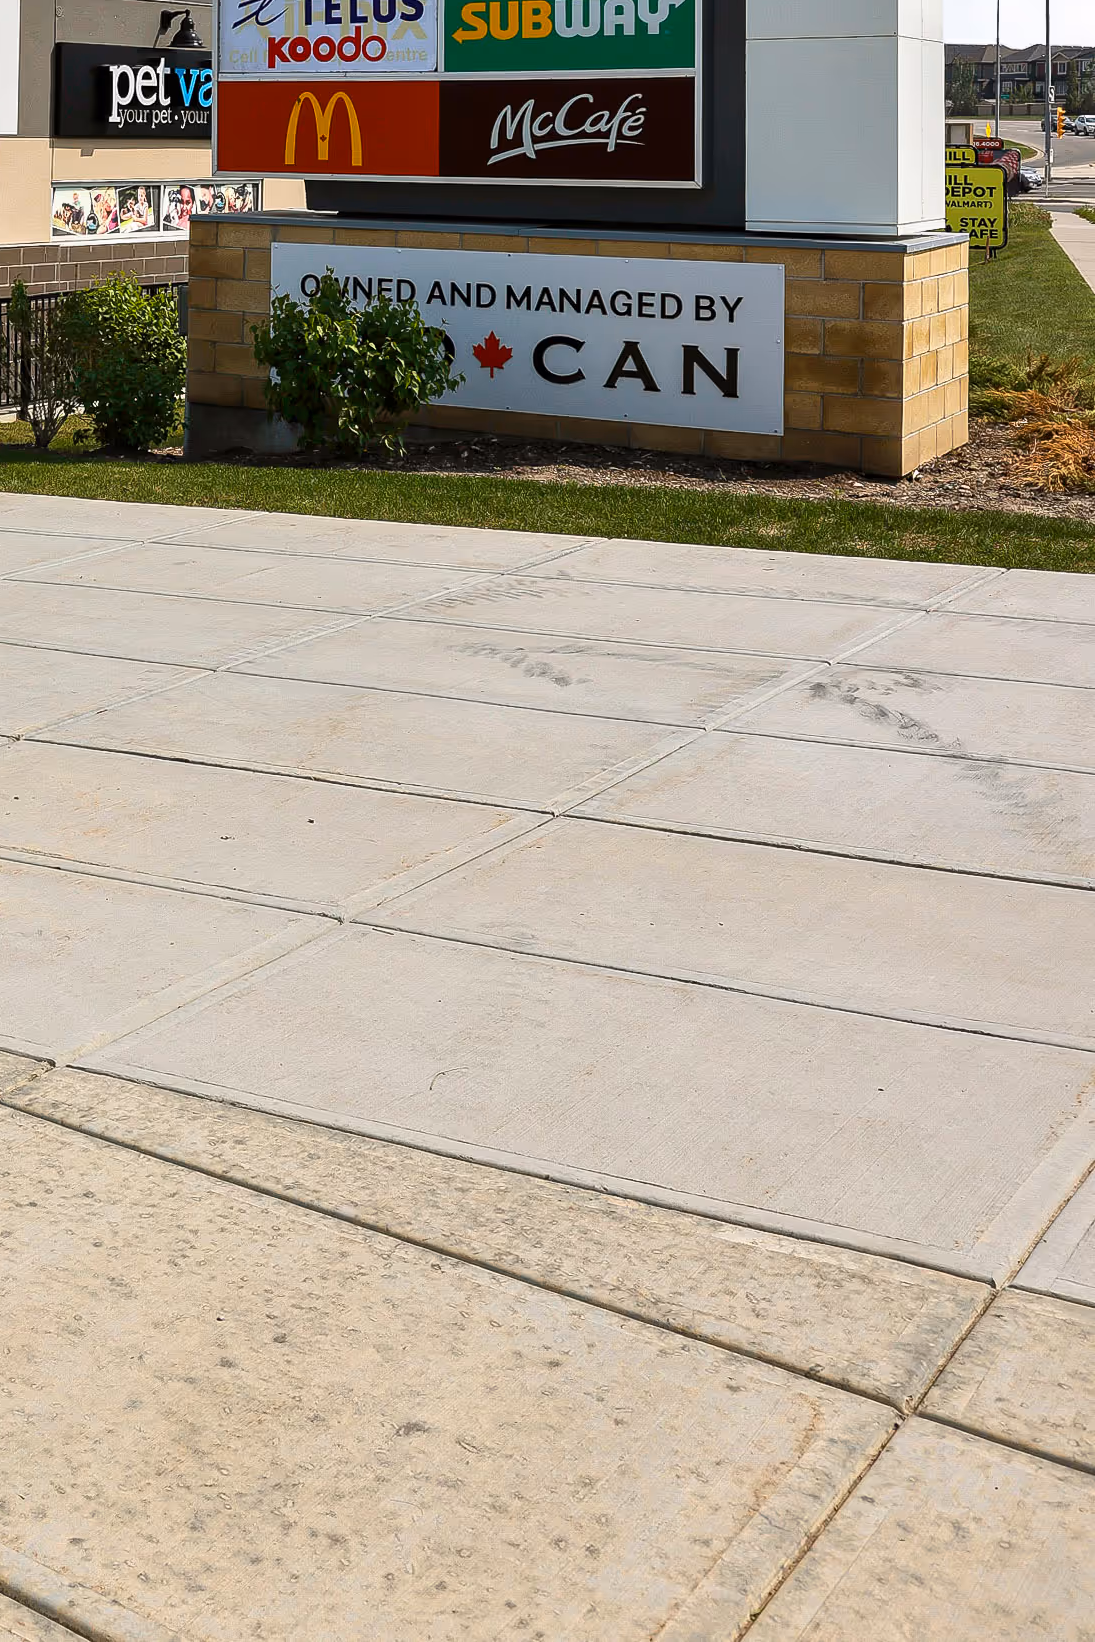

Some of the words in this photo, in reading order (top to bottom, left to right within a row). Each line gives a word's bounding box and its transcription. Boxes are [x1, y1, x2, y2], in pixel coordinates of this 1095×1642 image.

[109, 57, 171, 123] pet
[117, 108, 149, 128] your
[151, 107, 173, 129] pet
[181, 109, 209, 129] your
[488, 93, 647, 163] McCafé
[959, 217, 998, 229] STAY
[426, 280, 497, 309] AND
[506, 285, 683, 319] MANAGED
[694, 293, 744, 323] BY
[533, 334, 741, 399] CAN
